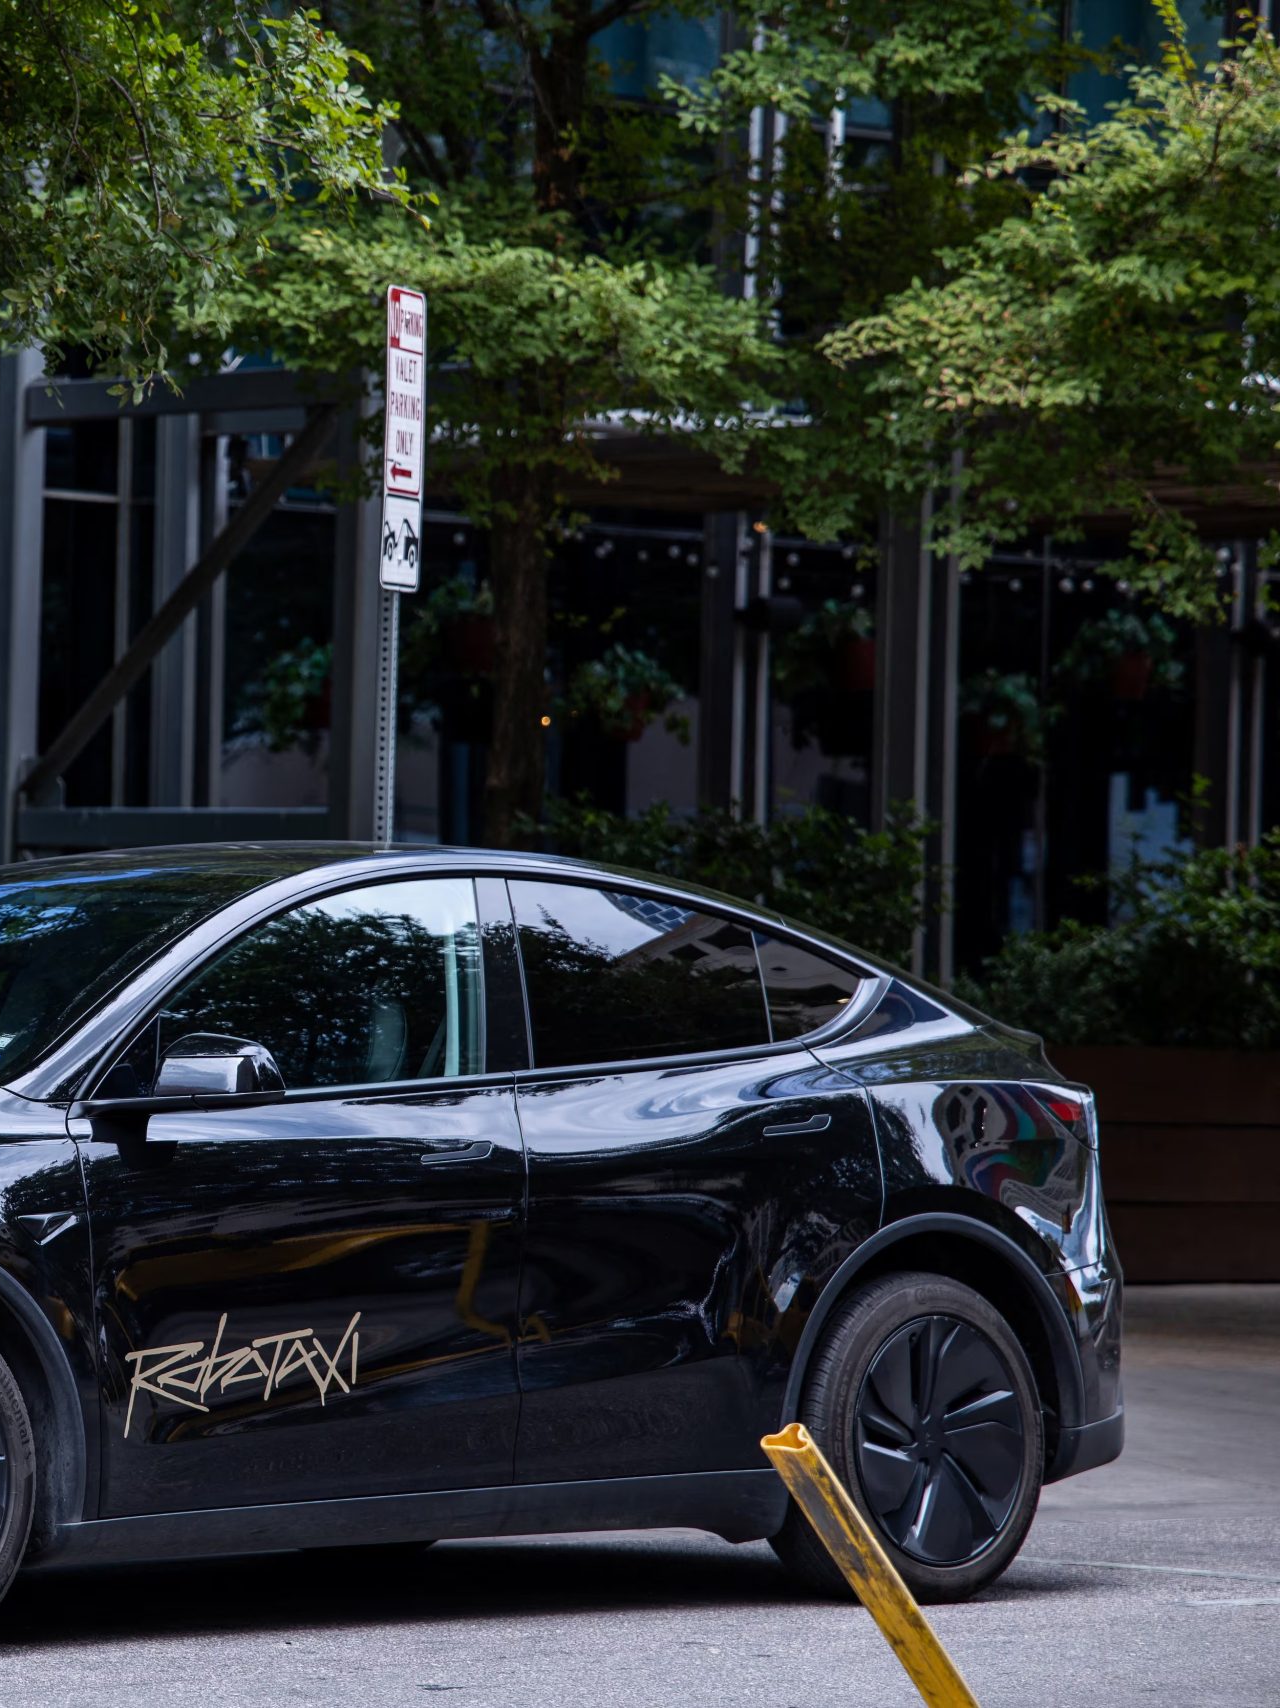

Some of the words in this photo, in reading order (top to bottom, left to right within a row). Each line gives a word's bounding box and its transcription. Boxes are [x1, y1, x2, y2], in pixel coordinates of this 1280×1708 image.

[390, 301, 400, 337] NO
[400, 308, 422, 338] PARKING
[395, 355, 417, 384] VALET
[390, 392, 420, 421] PARKING
[396, 430, 413, 456] ONLY
